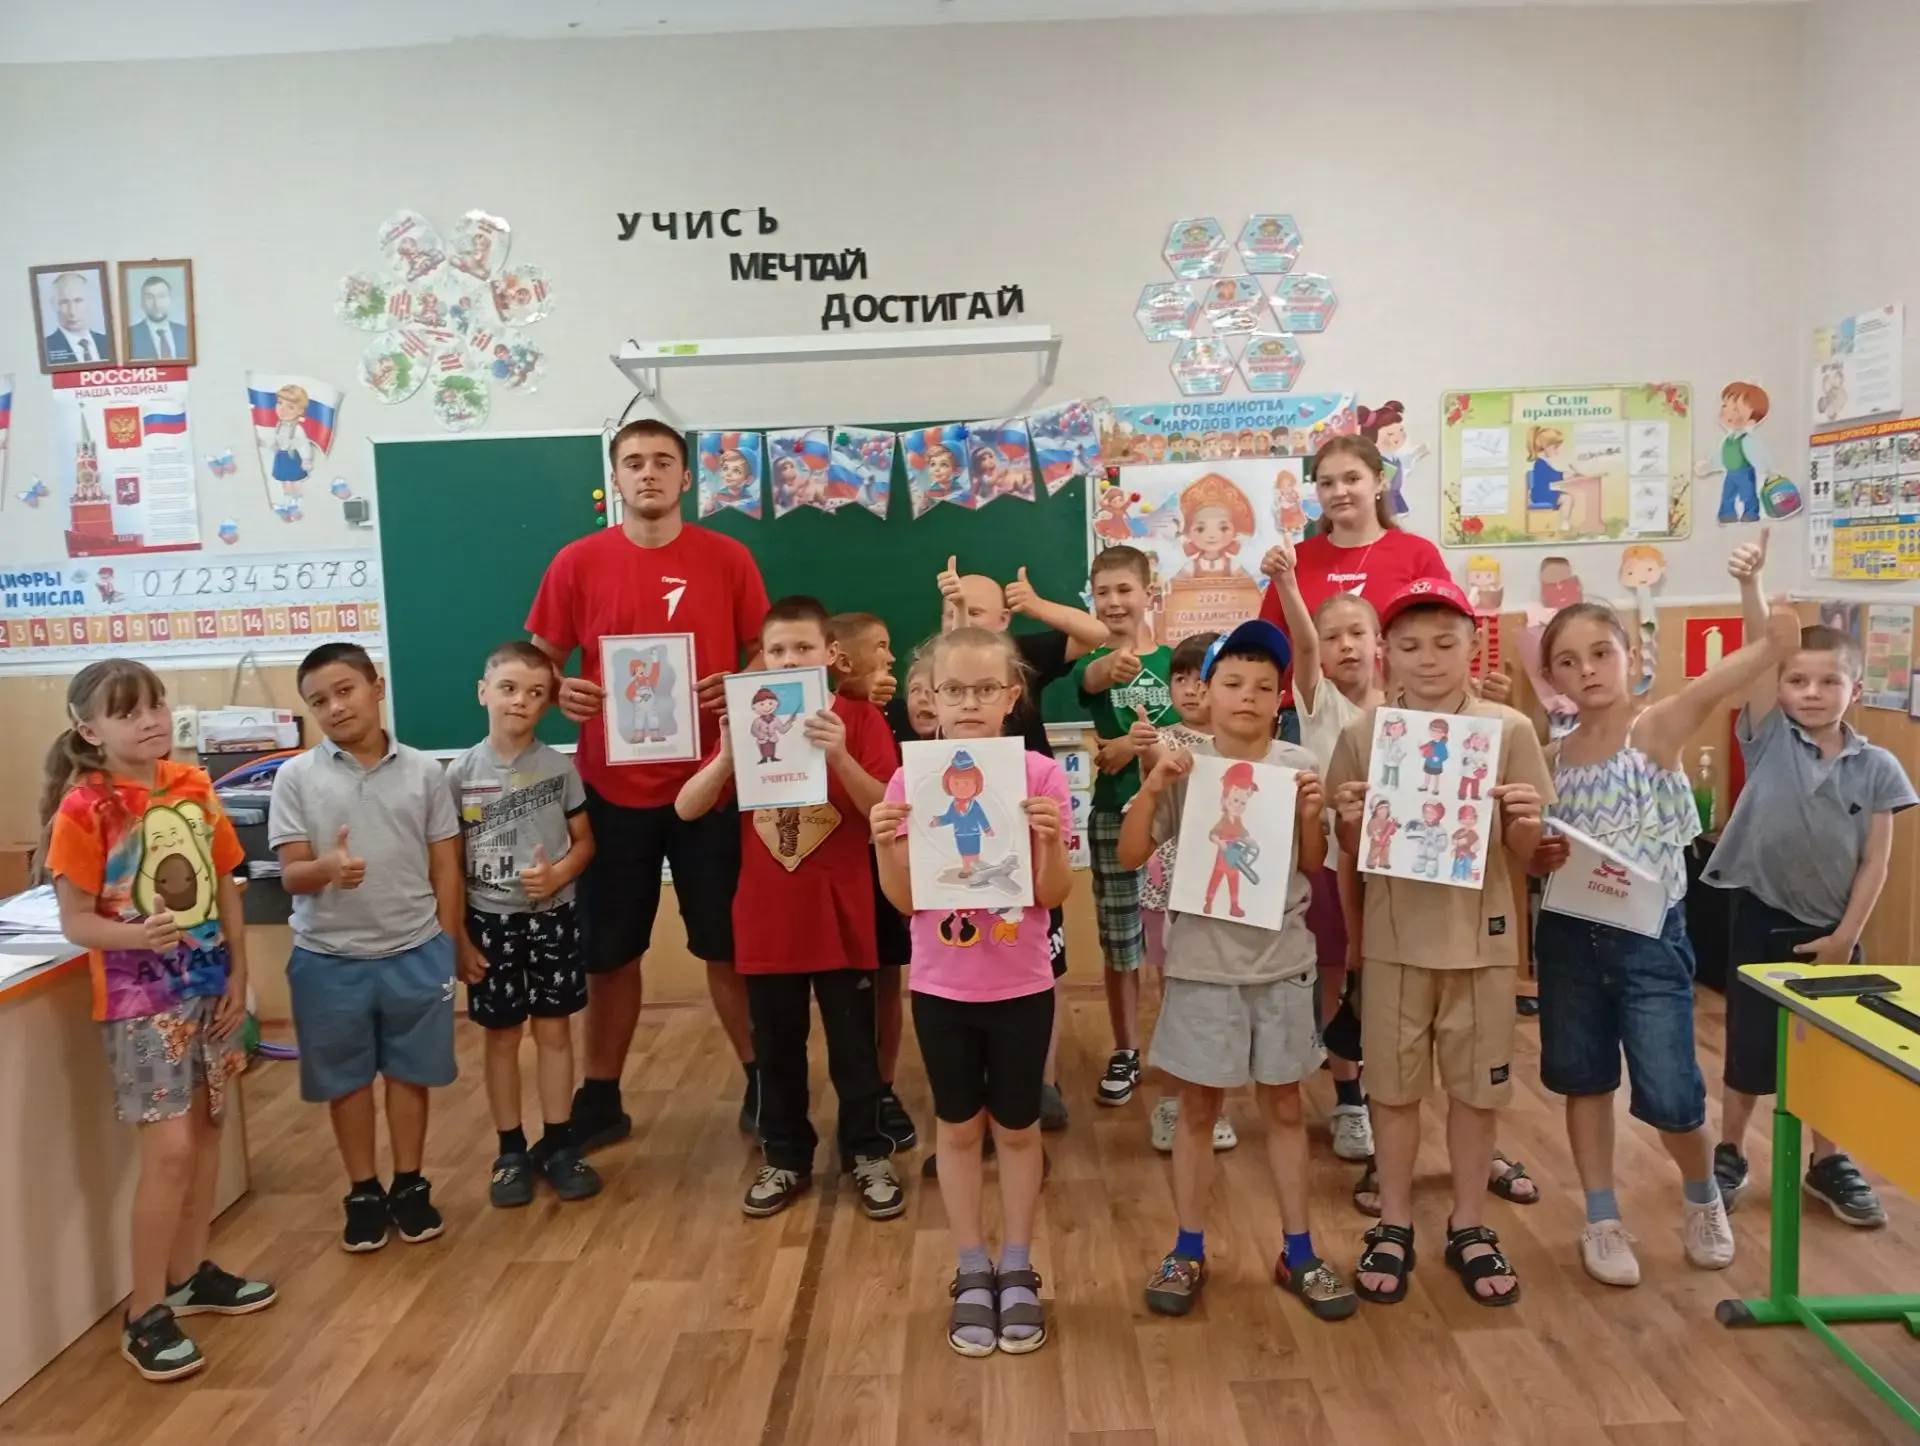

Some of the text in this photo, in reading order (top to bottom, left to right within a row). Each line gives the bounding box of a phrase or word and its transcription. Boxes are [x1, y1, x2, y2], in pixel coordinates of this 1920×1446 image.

[617, 206, 779, 240] УЧИСЬ
[730, 248, 868, 280] МЕЧТАЙ
[821, 285, 1025, 330] ДОСТИГАЙ
[75, 384, 168, 398] НАША РОДИНА!
[1545, 394, 1588, 406] Сиди
[1173, 400, 1285, 417] ГОД ЕДИНСТВА
[1522, 405, 1612, 421] правильно
[1161, 413, 1297, 432] НАРОДОВ РОССИИ
[143, 560, 367, 597] 0 1 2 3 4 5 6 7 8
[6, 590, 85, 608] И ЧИСЛА
[14, 625, 26, 642] 3
[34, 624, 46, 641] 4
[53, 623, 64, 640] 5
[72, 622, 86, 640] 6
[94, 621, 105, 639] 7
[112, 620, 126, 638] 8
[133, 619, 143, 636] 9
[150, 618, 168, 636] 10
[177, 618, 191, 634] 11
[197, 615, 215, 634] 12
[221, 615, 238, 633] 13
[243, 613, 262, 632] 14
[267, 612, 285, 630] 15
[291, 611, 309, 630] 16
[316, 609, 332, 628] 17
[338, 609, 356, 627] 18
[363, 608, 380, 626] 19
[1065, 752, 1080, 772] Й
[761, 772, 808, 784] УЧИТЕЛЬ
[1587, 880, 1628, 899] ПОВАР
